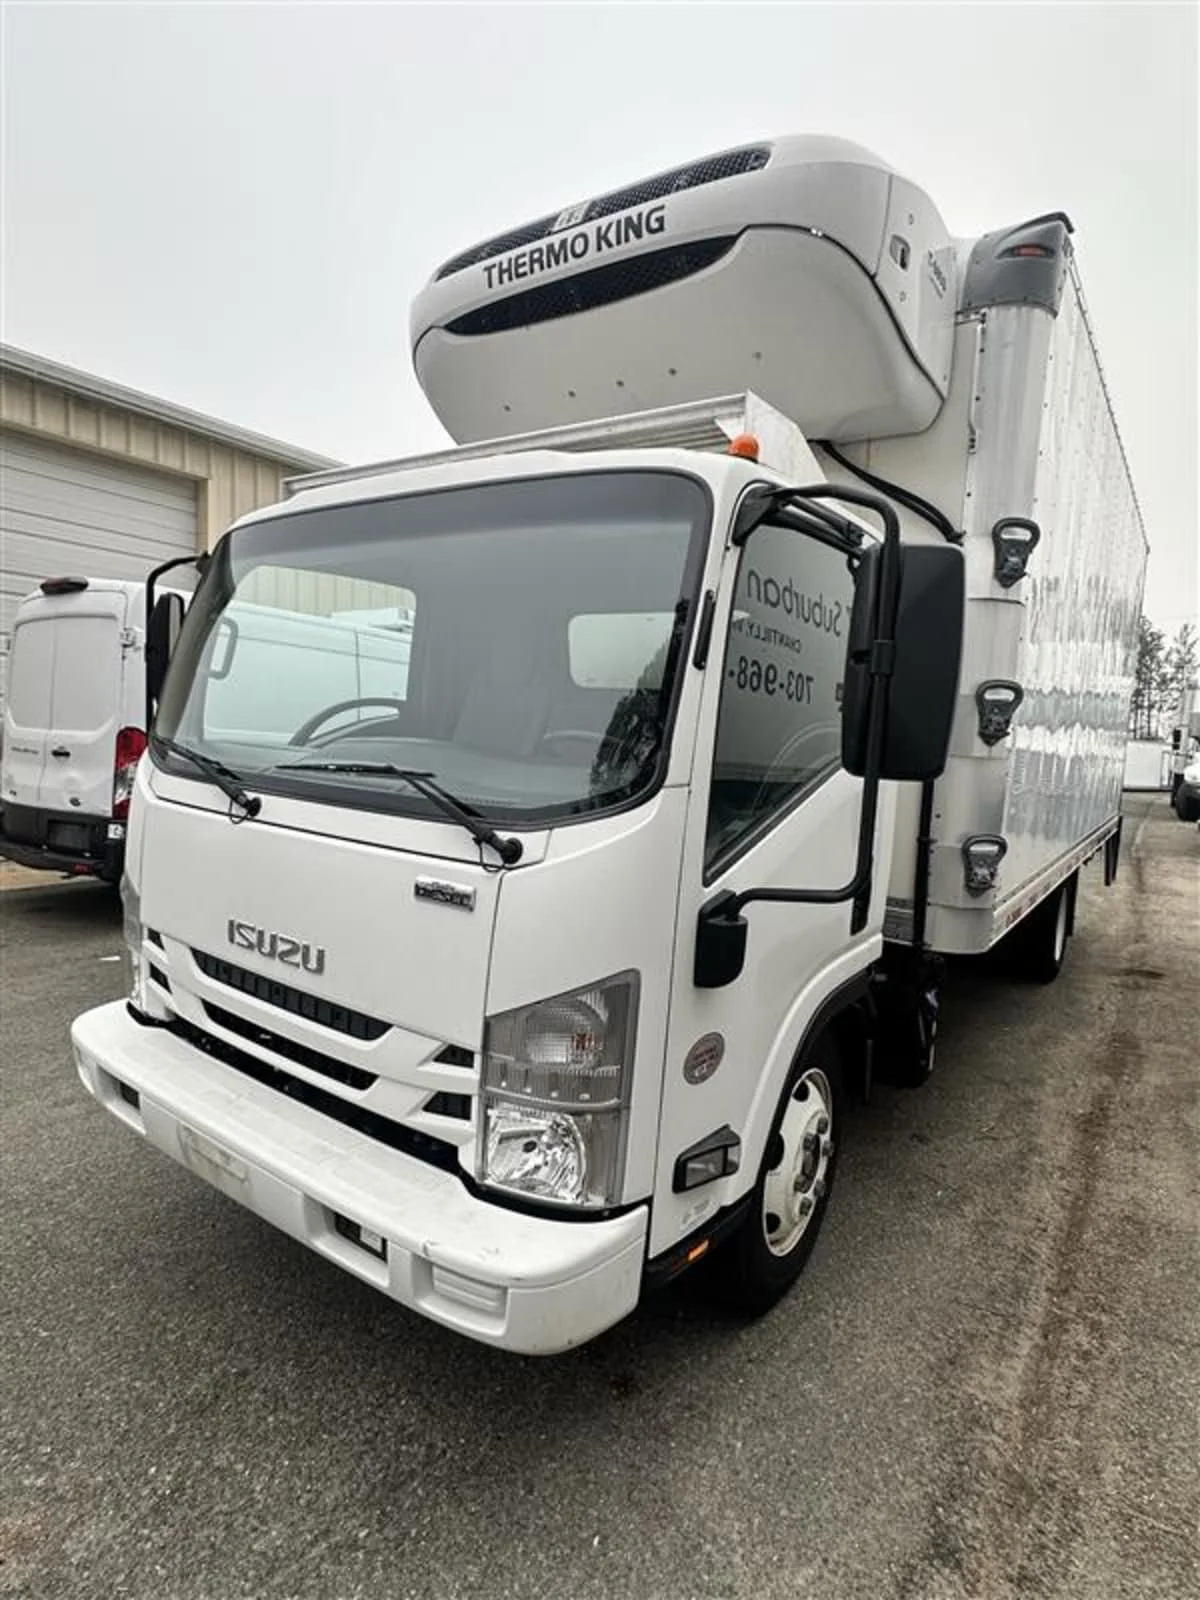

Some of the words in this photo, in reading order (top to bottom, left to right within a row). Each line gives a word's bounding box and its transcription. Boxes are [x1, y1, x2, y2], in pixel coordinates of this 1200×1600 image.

[483, 232, 589, 289] THERMO
[596, 205, 666, 252] KING
[227, 918, 326, 976] ISUZU
